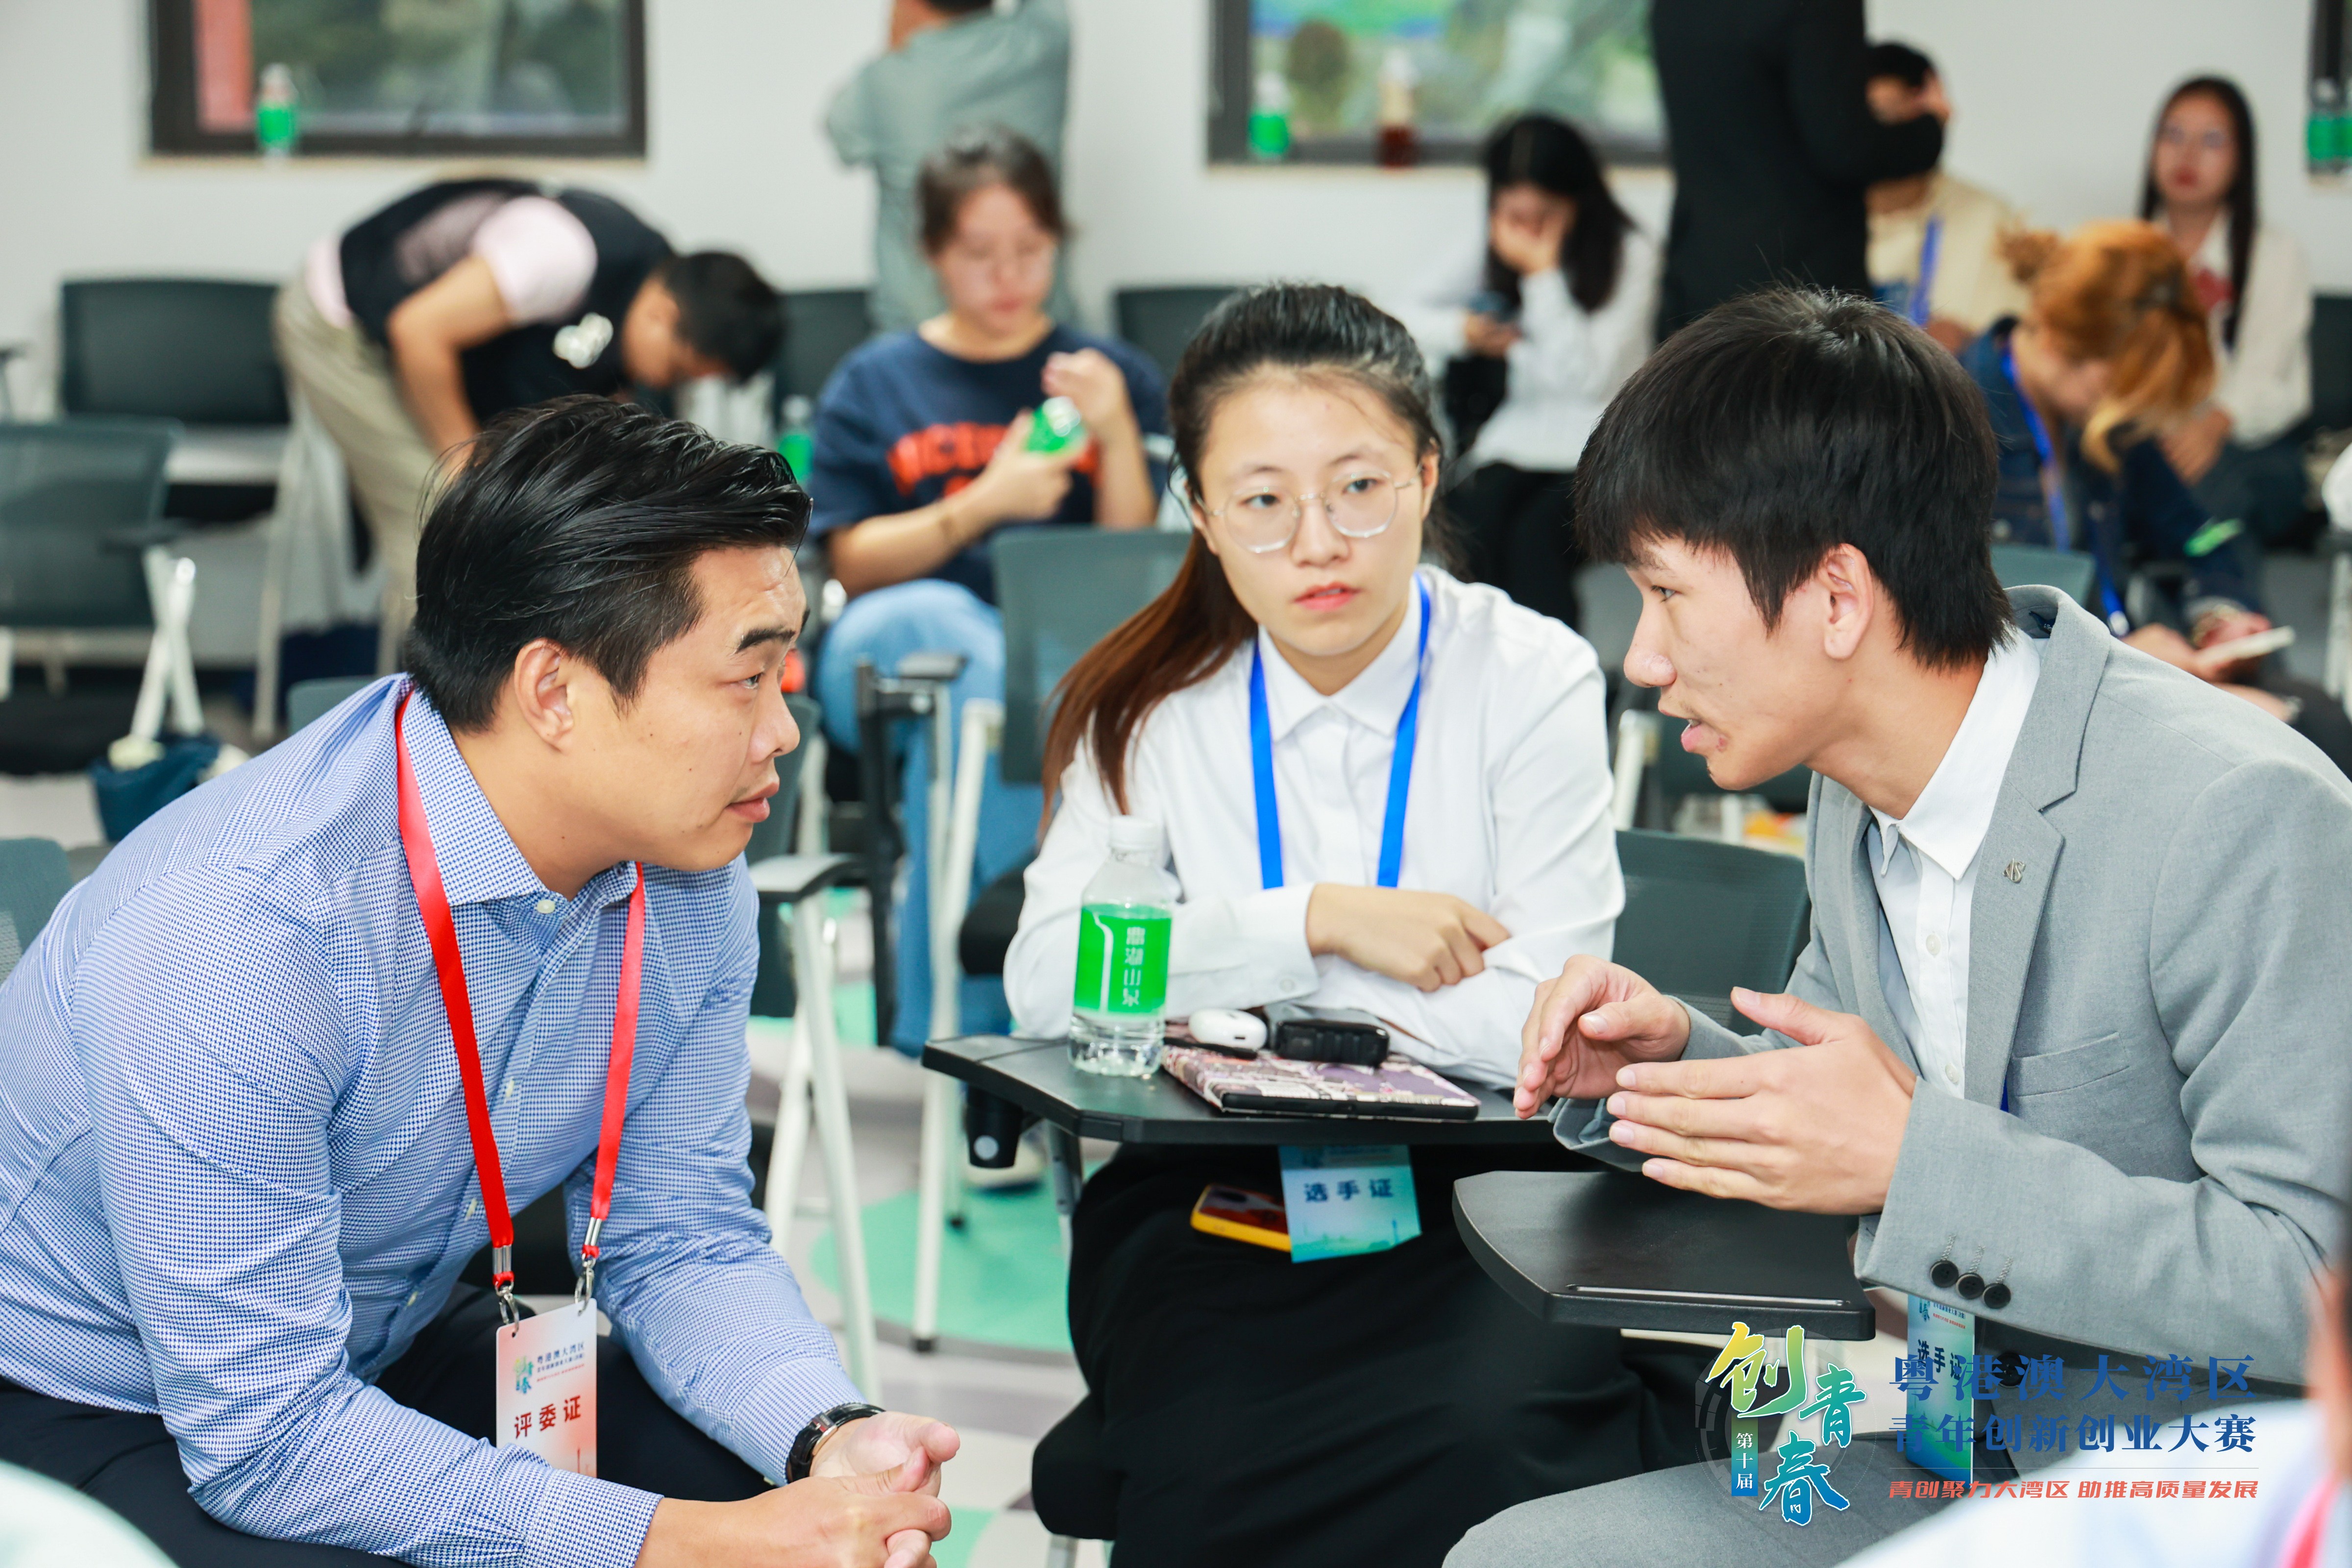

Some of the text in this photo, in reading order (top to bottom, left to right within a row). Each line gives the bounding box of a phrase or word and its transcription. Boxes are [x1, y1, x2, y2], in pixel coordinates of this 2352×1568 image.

[1303, 1178, 1394, 1203] 选手证
[514, 1395, 581, 1439] 评委证
